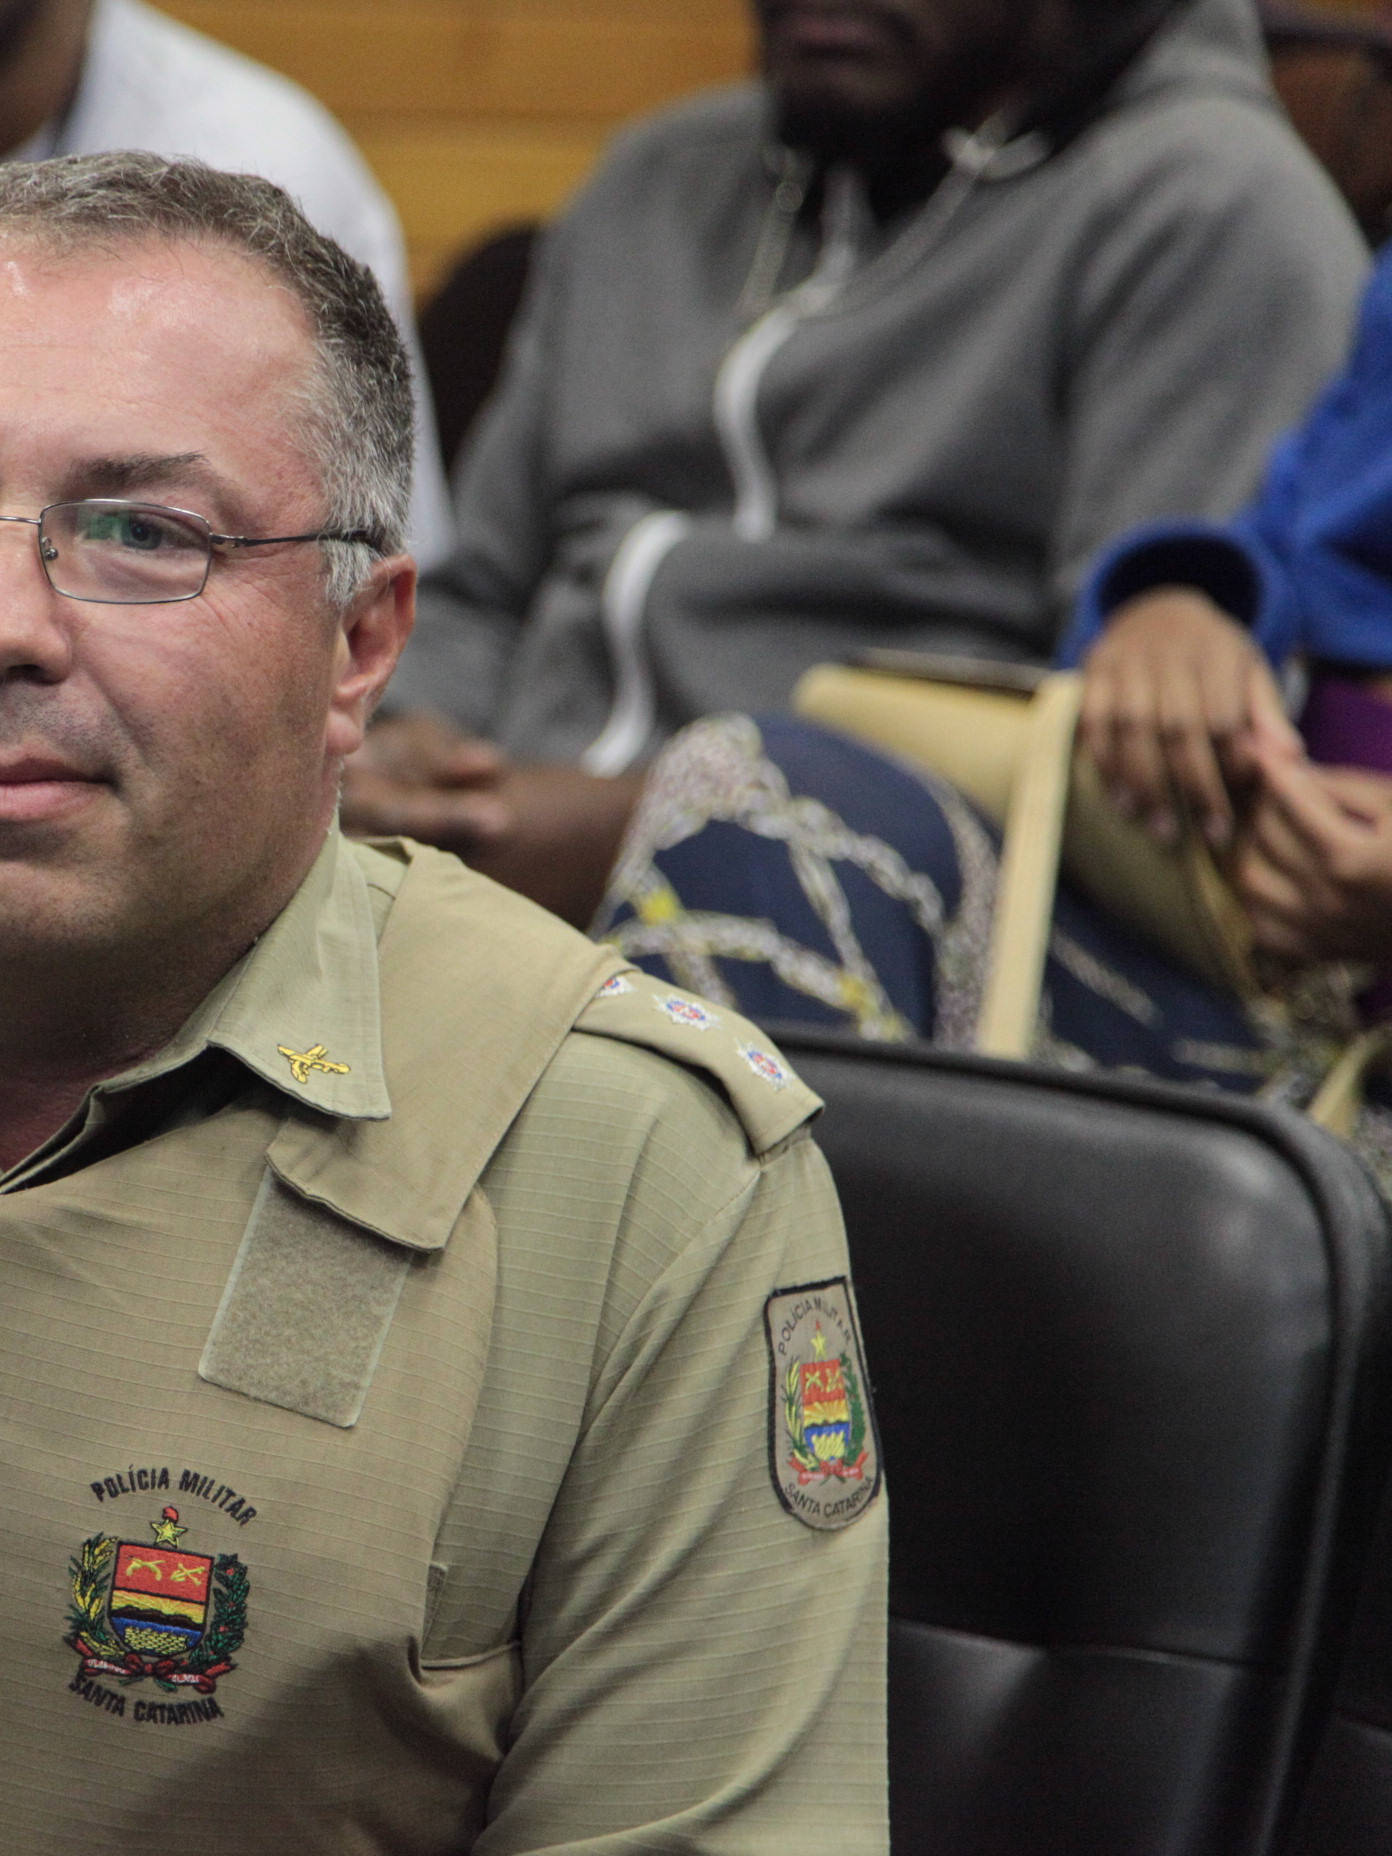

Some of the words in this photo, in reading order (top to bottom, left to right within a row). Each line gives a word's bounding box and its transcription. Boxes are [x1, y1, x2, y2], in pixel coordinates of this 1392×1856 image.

[90, 1465, 170, 1502] POLÍCIA
[179, 1469, 257, 1527] MILITAR
[785, 1482, 821, 1514] SANTA
[69, 1674, 126, 1717] SANTA
[134, 1696, 225, 1725] CATARINA
